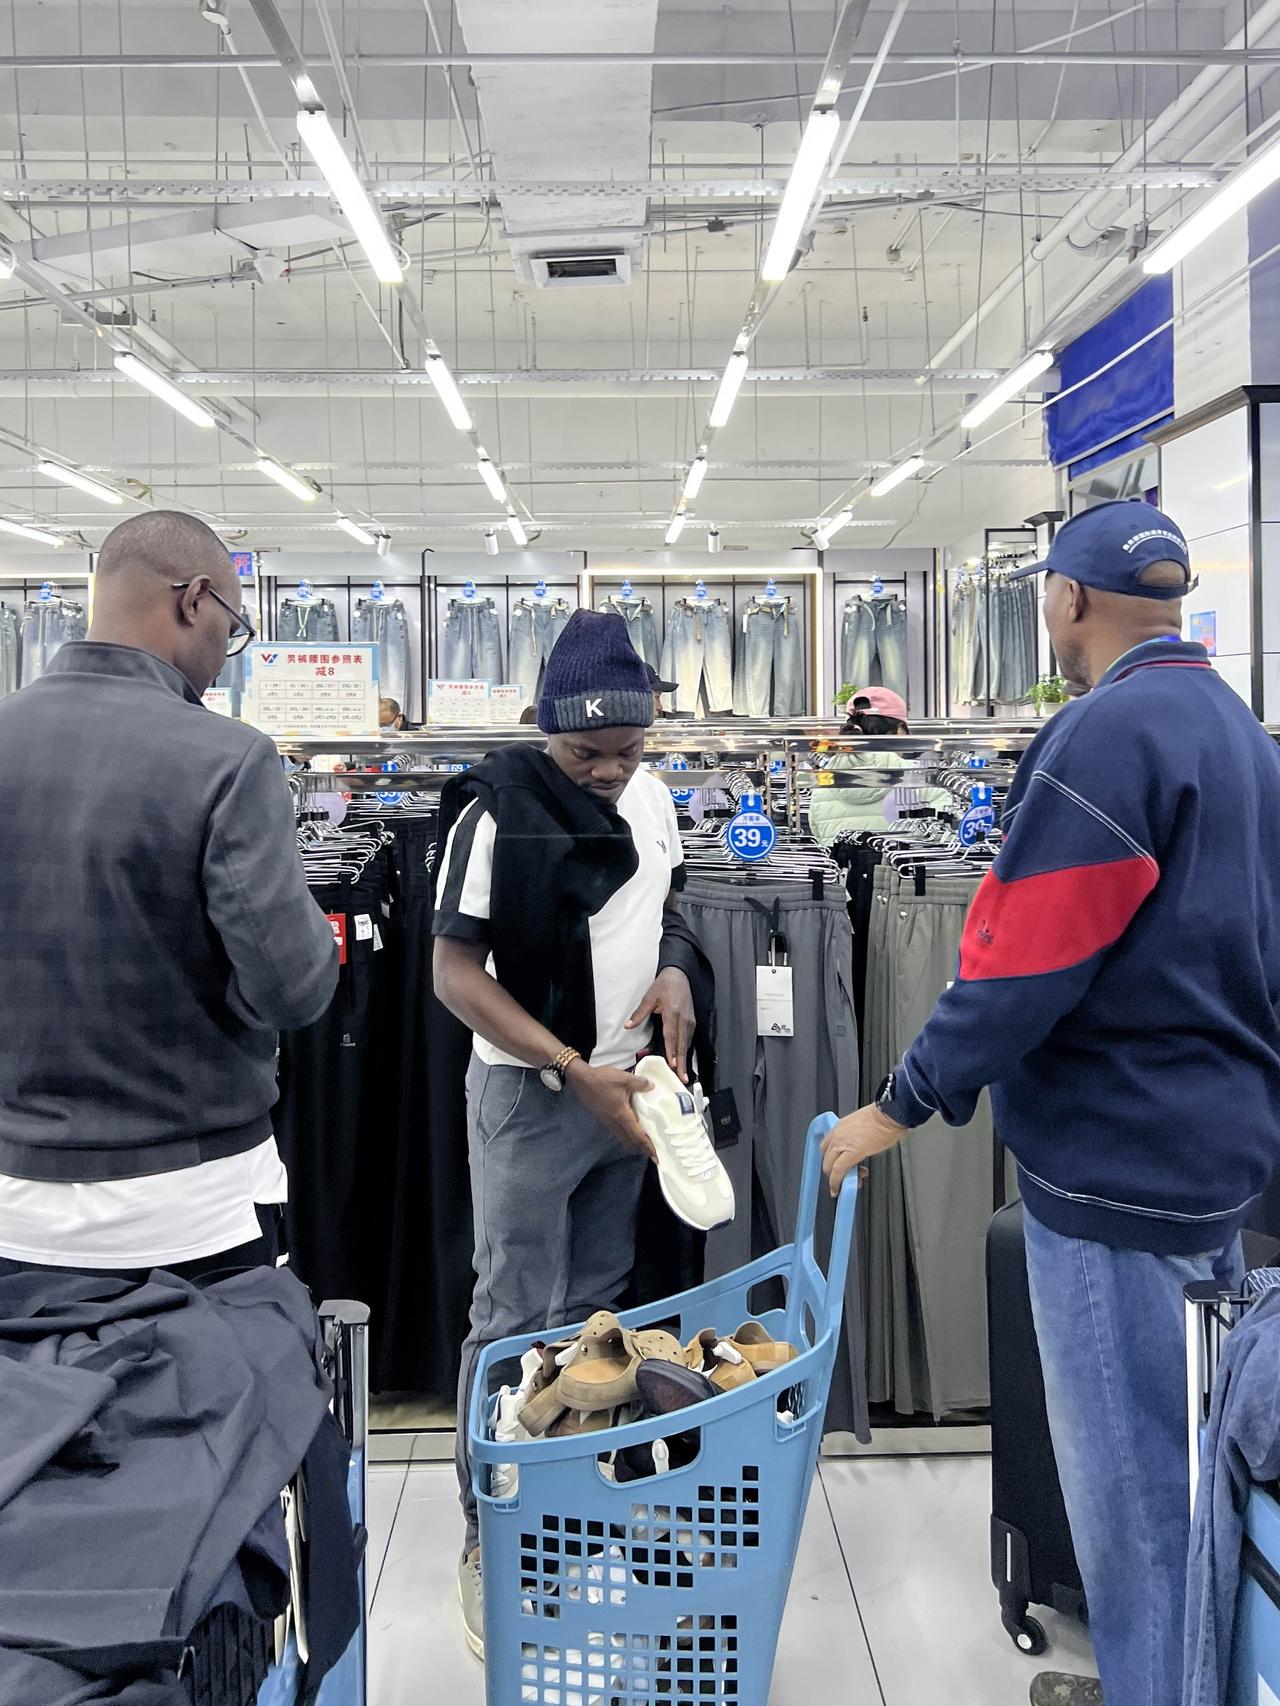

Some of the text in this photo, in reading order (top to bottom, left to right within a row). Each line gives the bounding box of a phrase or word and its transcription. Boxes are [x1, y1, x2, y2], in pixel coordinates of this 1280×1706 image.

[287, 654, 364, 664] 男裤腰围参照表
[585, 698, 604, 718] K
